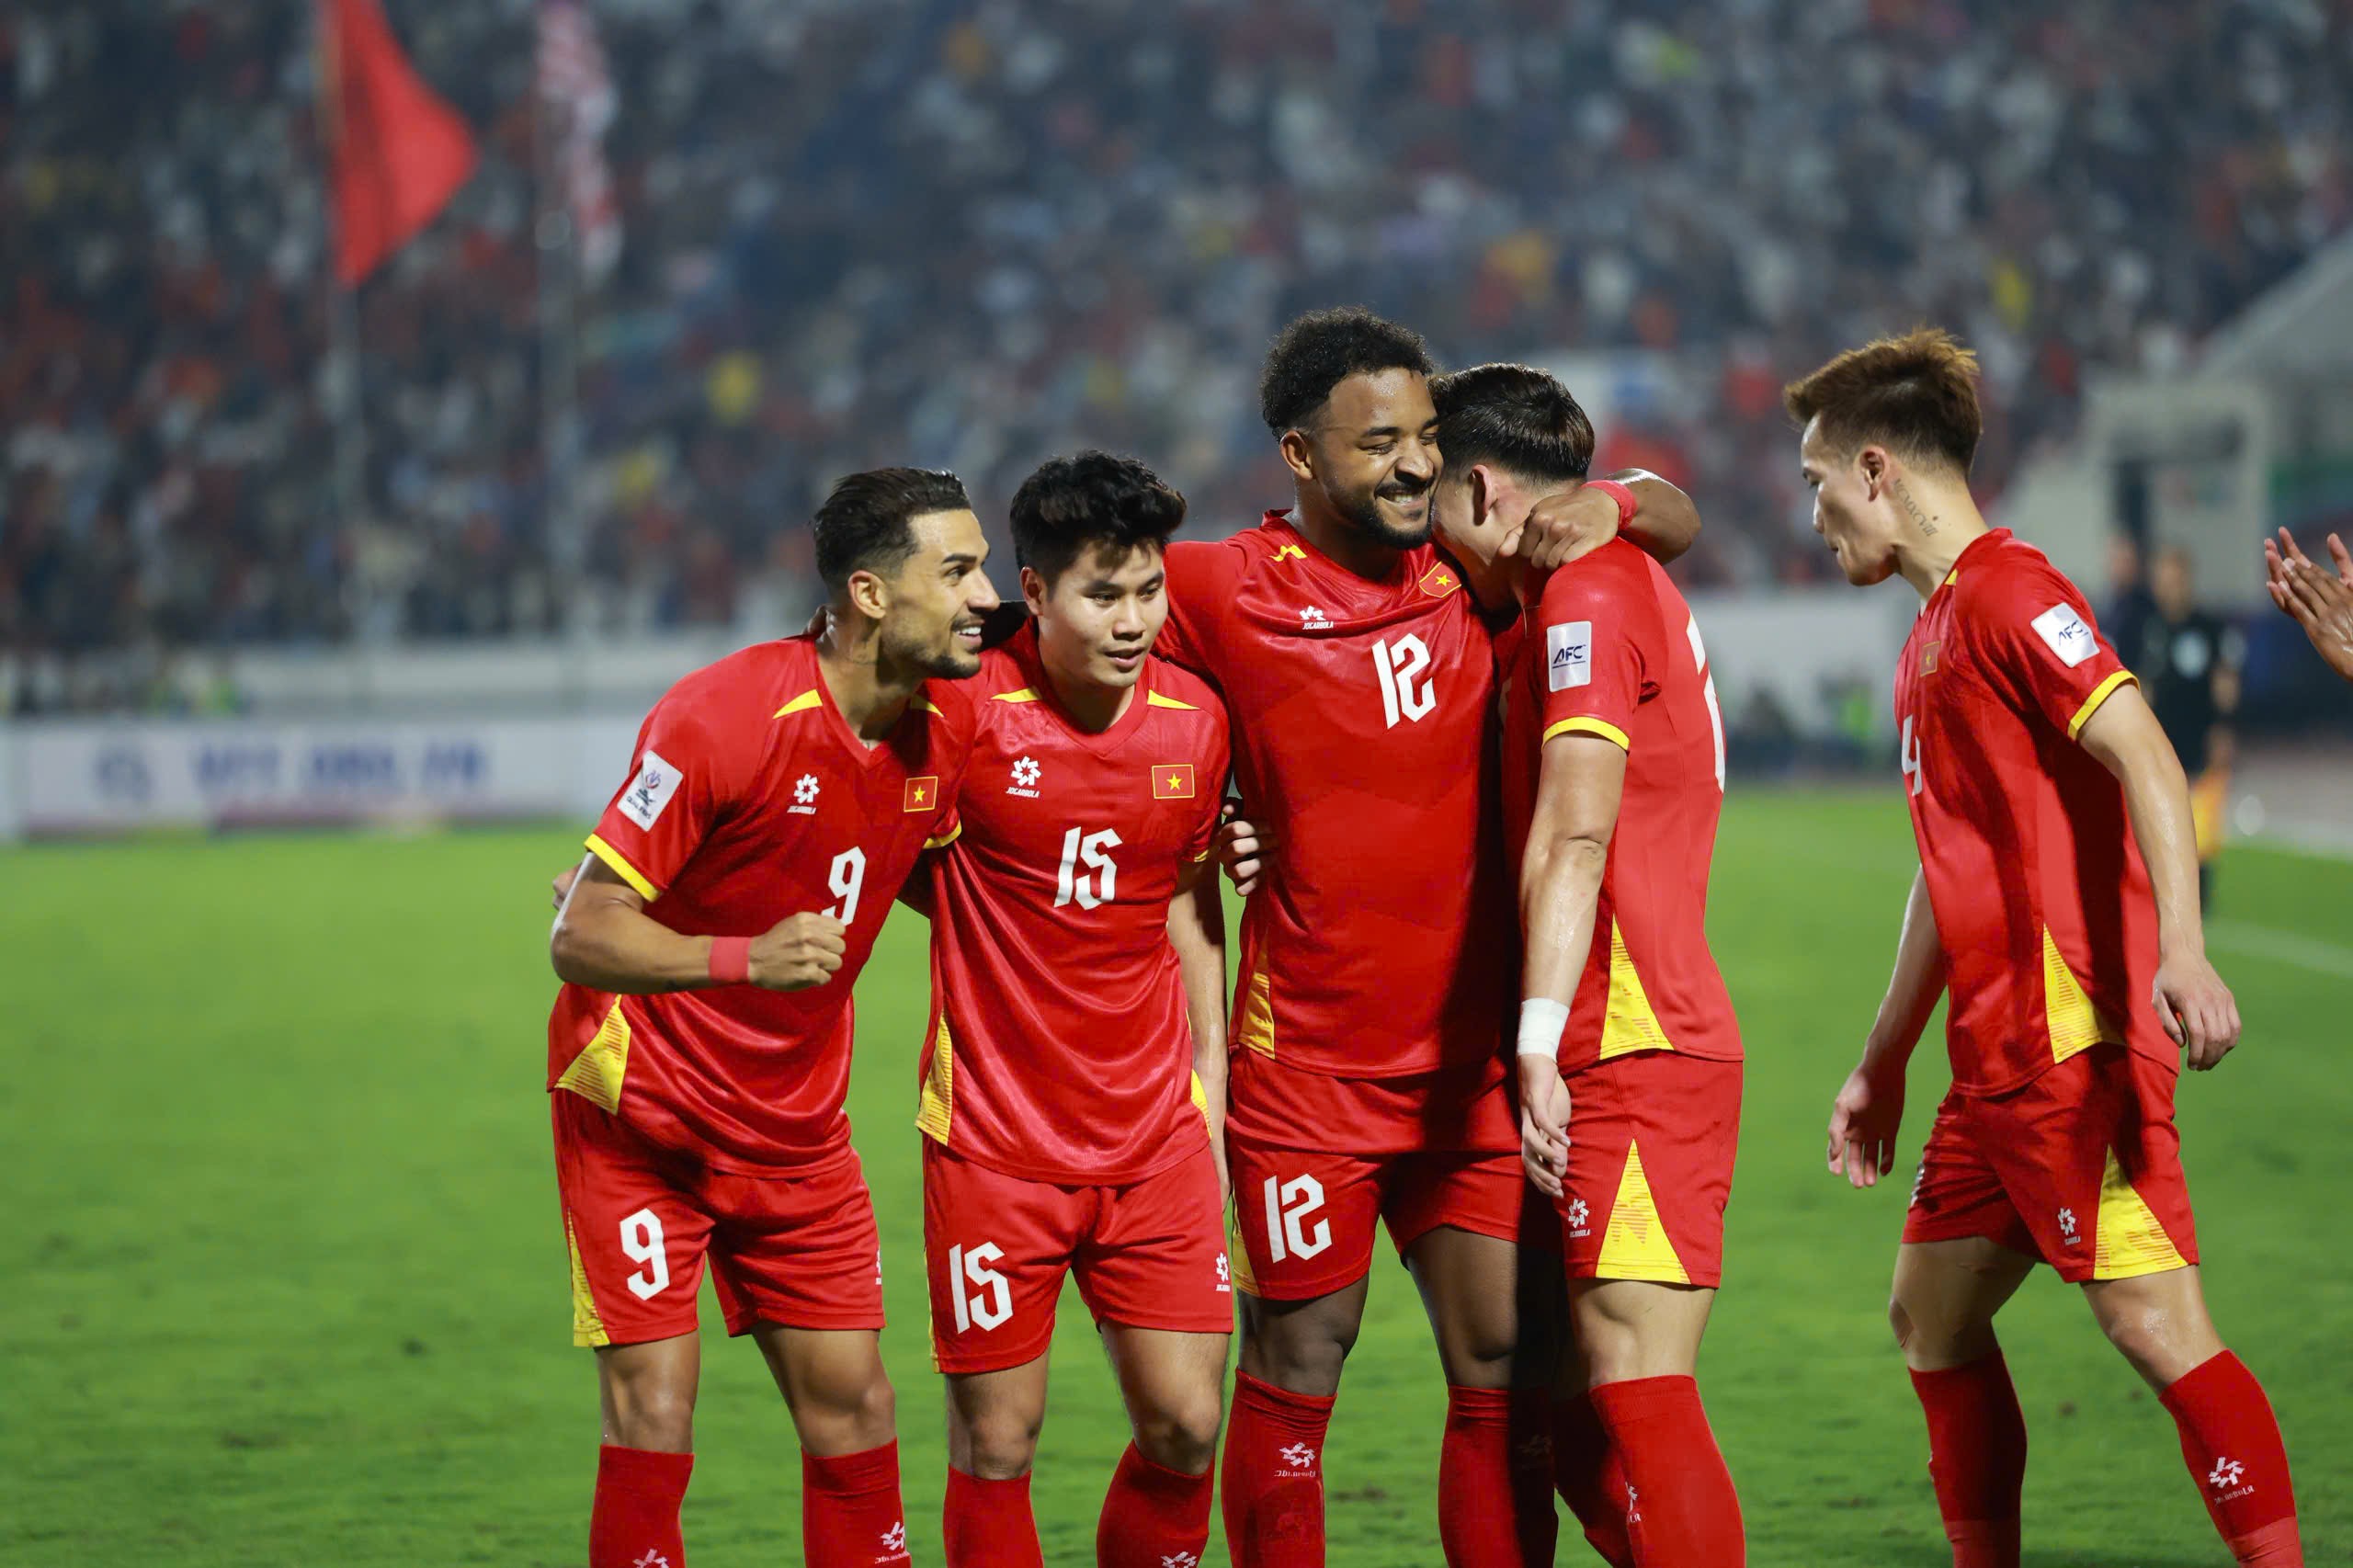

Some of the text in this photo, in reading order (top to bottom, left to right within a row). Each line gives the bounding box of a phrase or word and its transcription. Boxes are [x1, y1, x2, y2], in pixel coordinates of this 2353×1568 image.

[1553, 644, 1586, 665] AFC
[2058, 619, 2084, 646] AFC
[1371, 632, 1437, 729] 12
[821, 846, 867, 927] 9
[1053, 825, 1123, 910] 15
[619, 1207, 671, 1301] 9
[1264, 1173, 1333, 1264] 12
[949, 1241, 1014, 1335] 15
